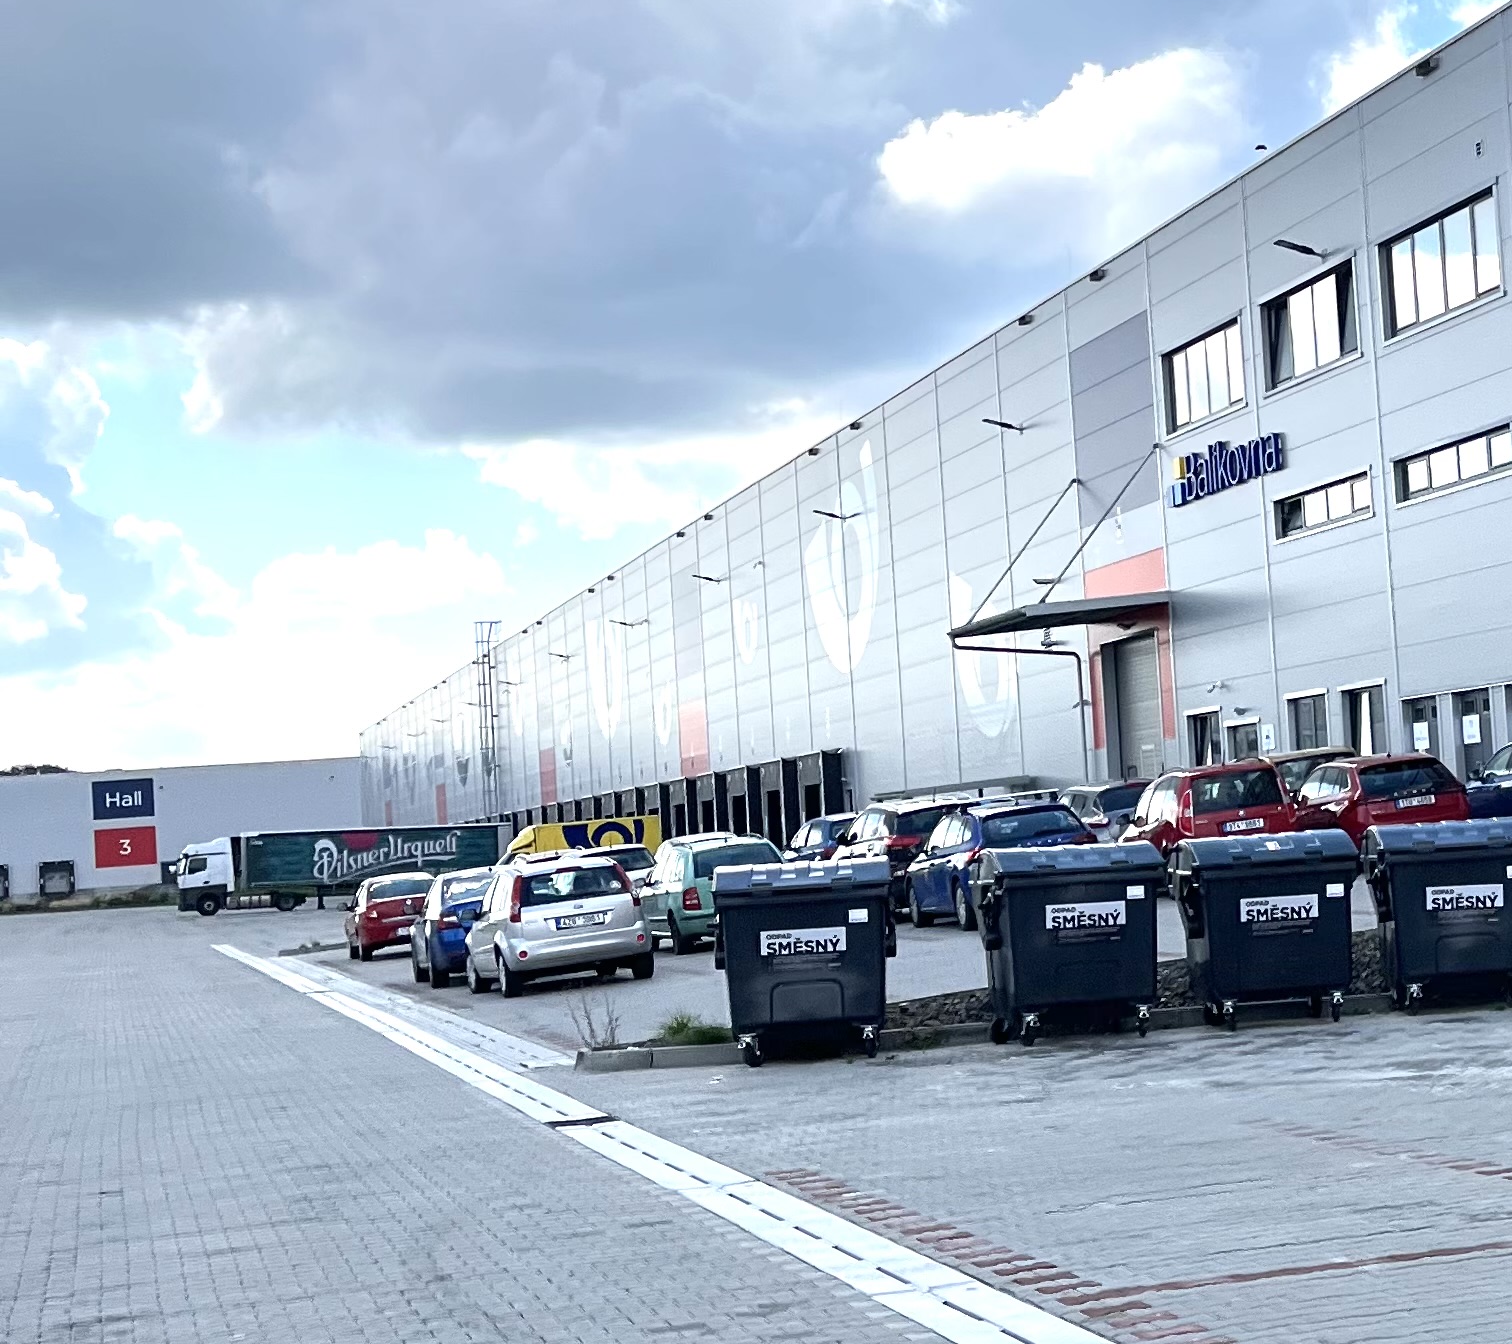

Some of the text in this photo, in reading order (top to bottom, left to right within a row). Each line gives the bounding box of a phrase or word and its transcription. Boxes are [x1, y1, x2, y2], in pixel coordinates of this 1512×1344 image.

[1184, 432, 1284, 502] Balíkovna
[105, 790, 143, 809] Hall
[118, 839, 132, 856] 3
[313, 830, 461, 885] Pilsner Urquell
[1245, 901, 1313, 923] SMĚSNÝ
[1431, 891, 1499, 911] SMĚSNÝ
[1051, 908, 1121, 930] SMĚSNÝ
[766, 934, 841, 958] SMĚSNÝ
